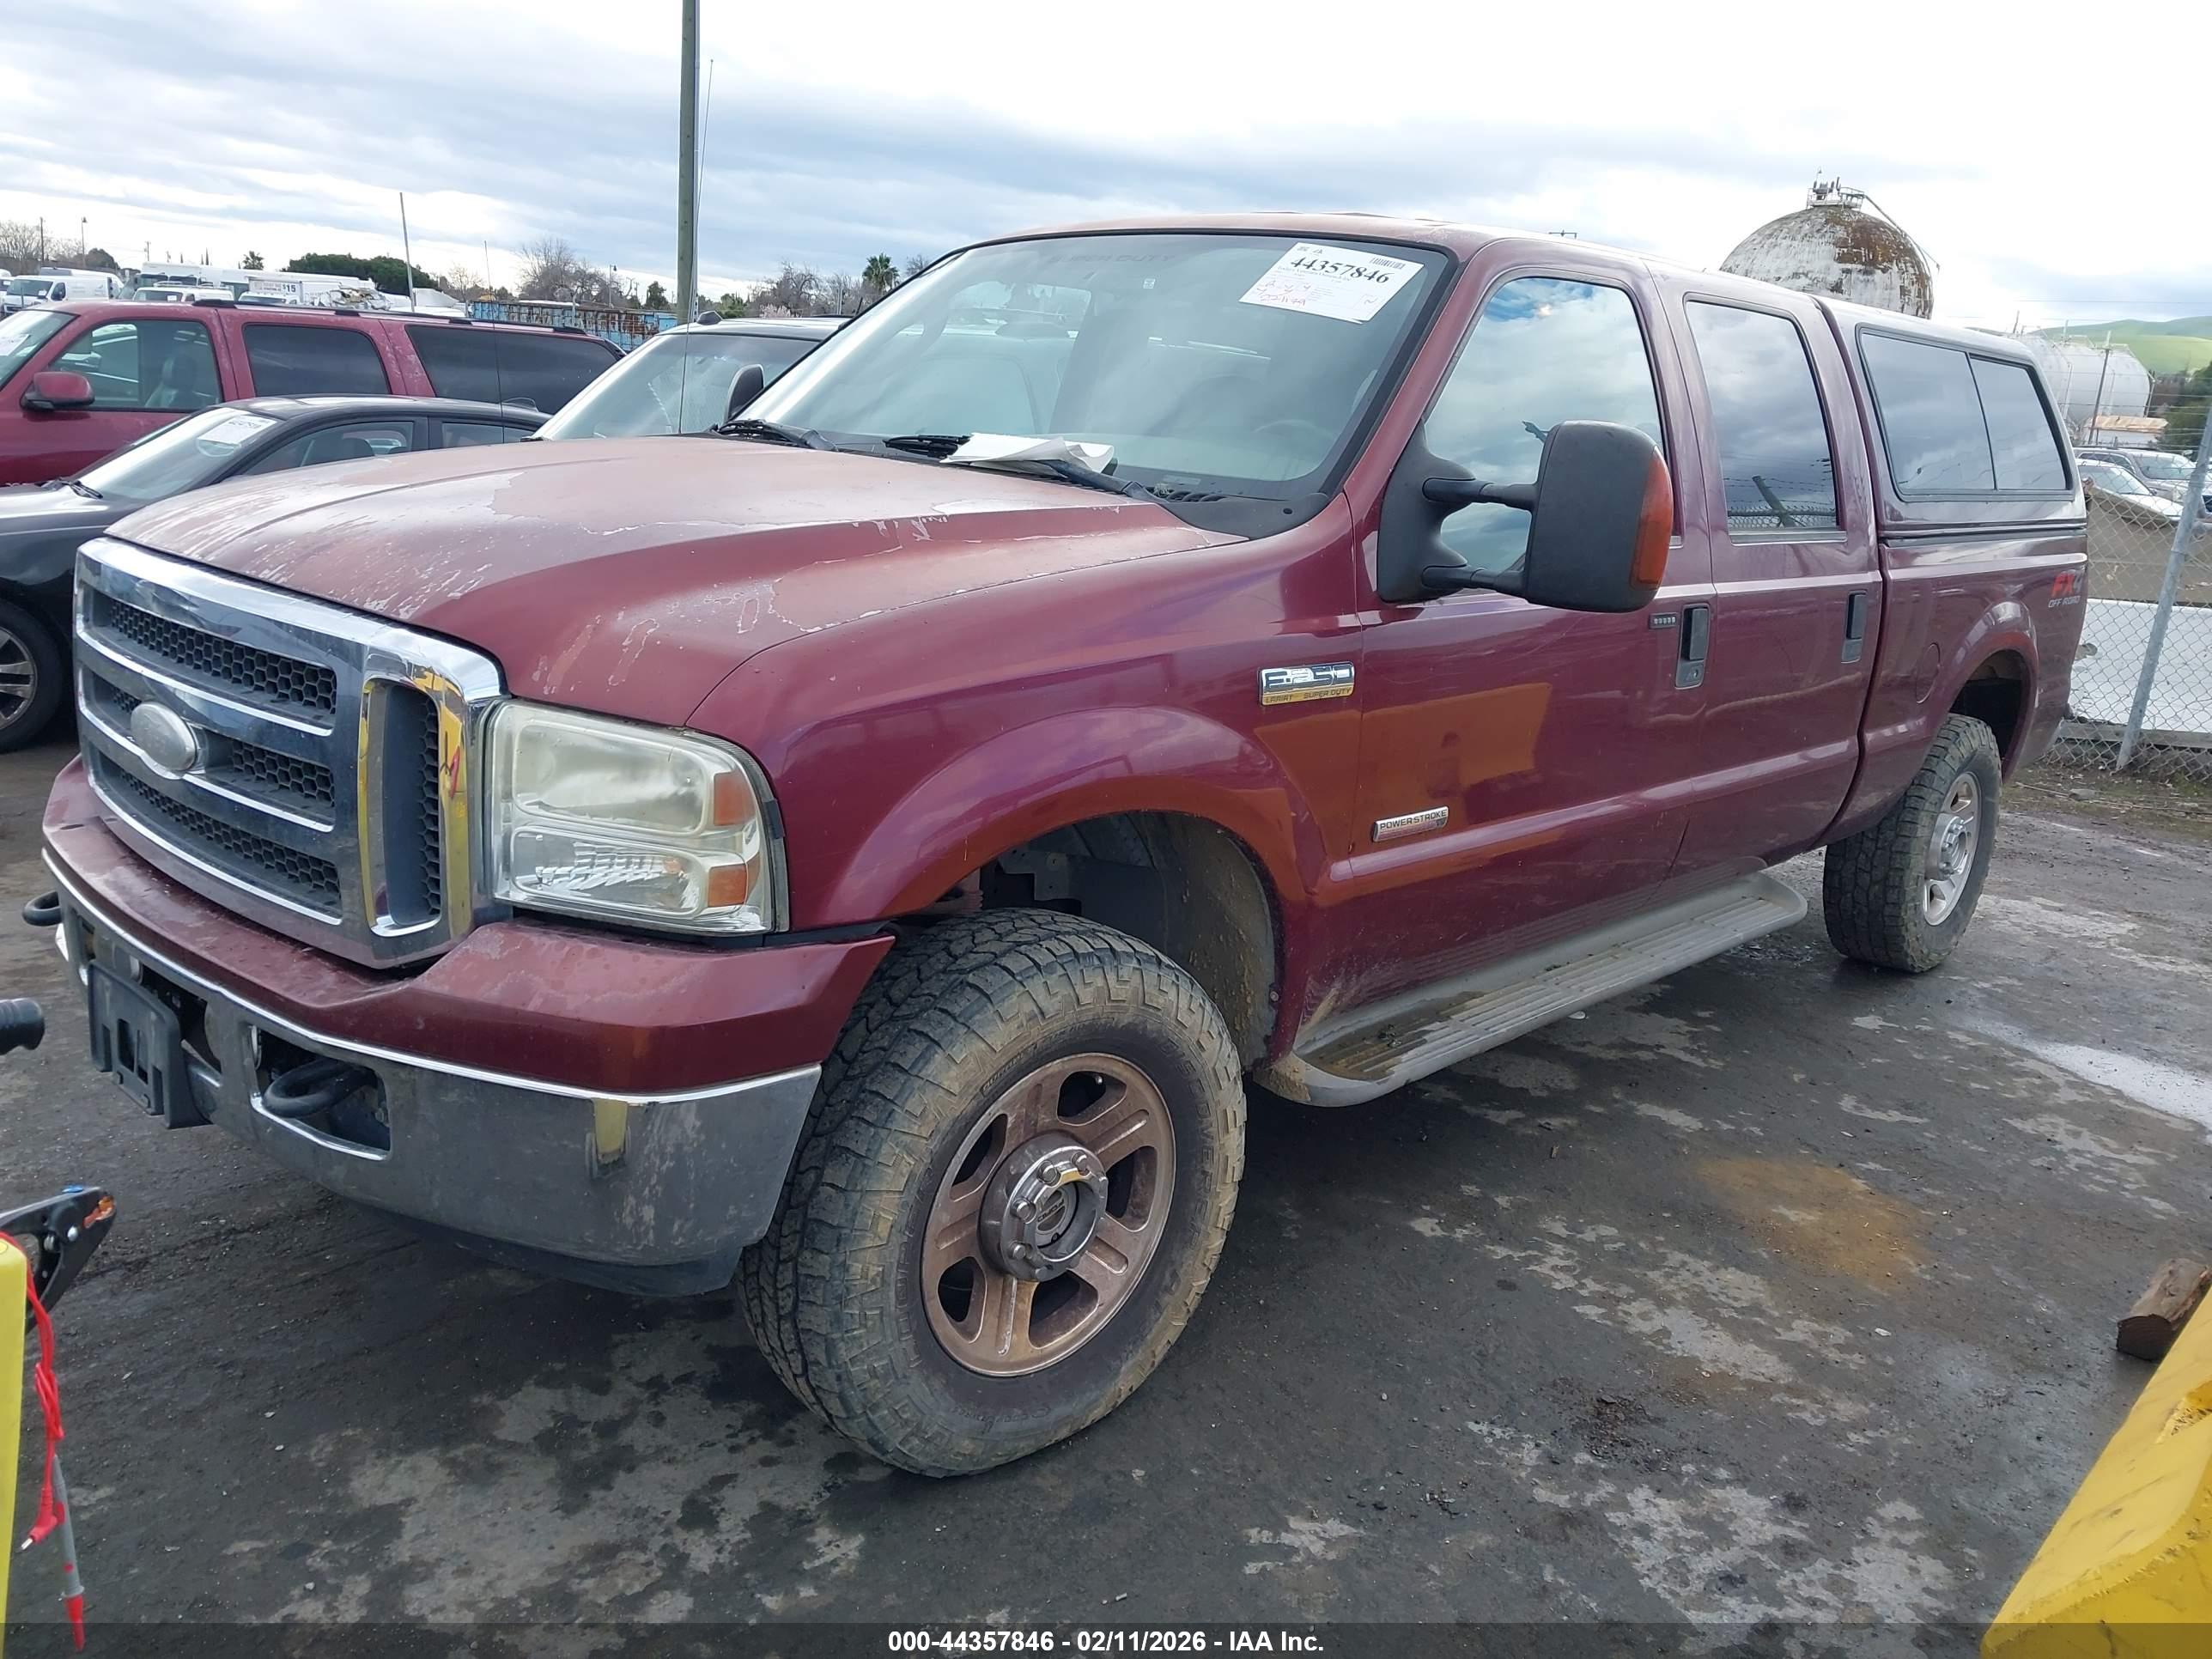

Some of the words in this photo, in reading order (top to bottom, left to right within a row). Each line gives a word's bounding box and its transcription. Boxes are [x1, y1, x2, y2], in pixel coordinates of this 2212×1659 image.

[1291, 257, 1395, 283] 44357846
[1304, 690, 1328, 699] SUPER
[1330, 686, 1352, 696] DUTY
